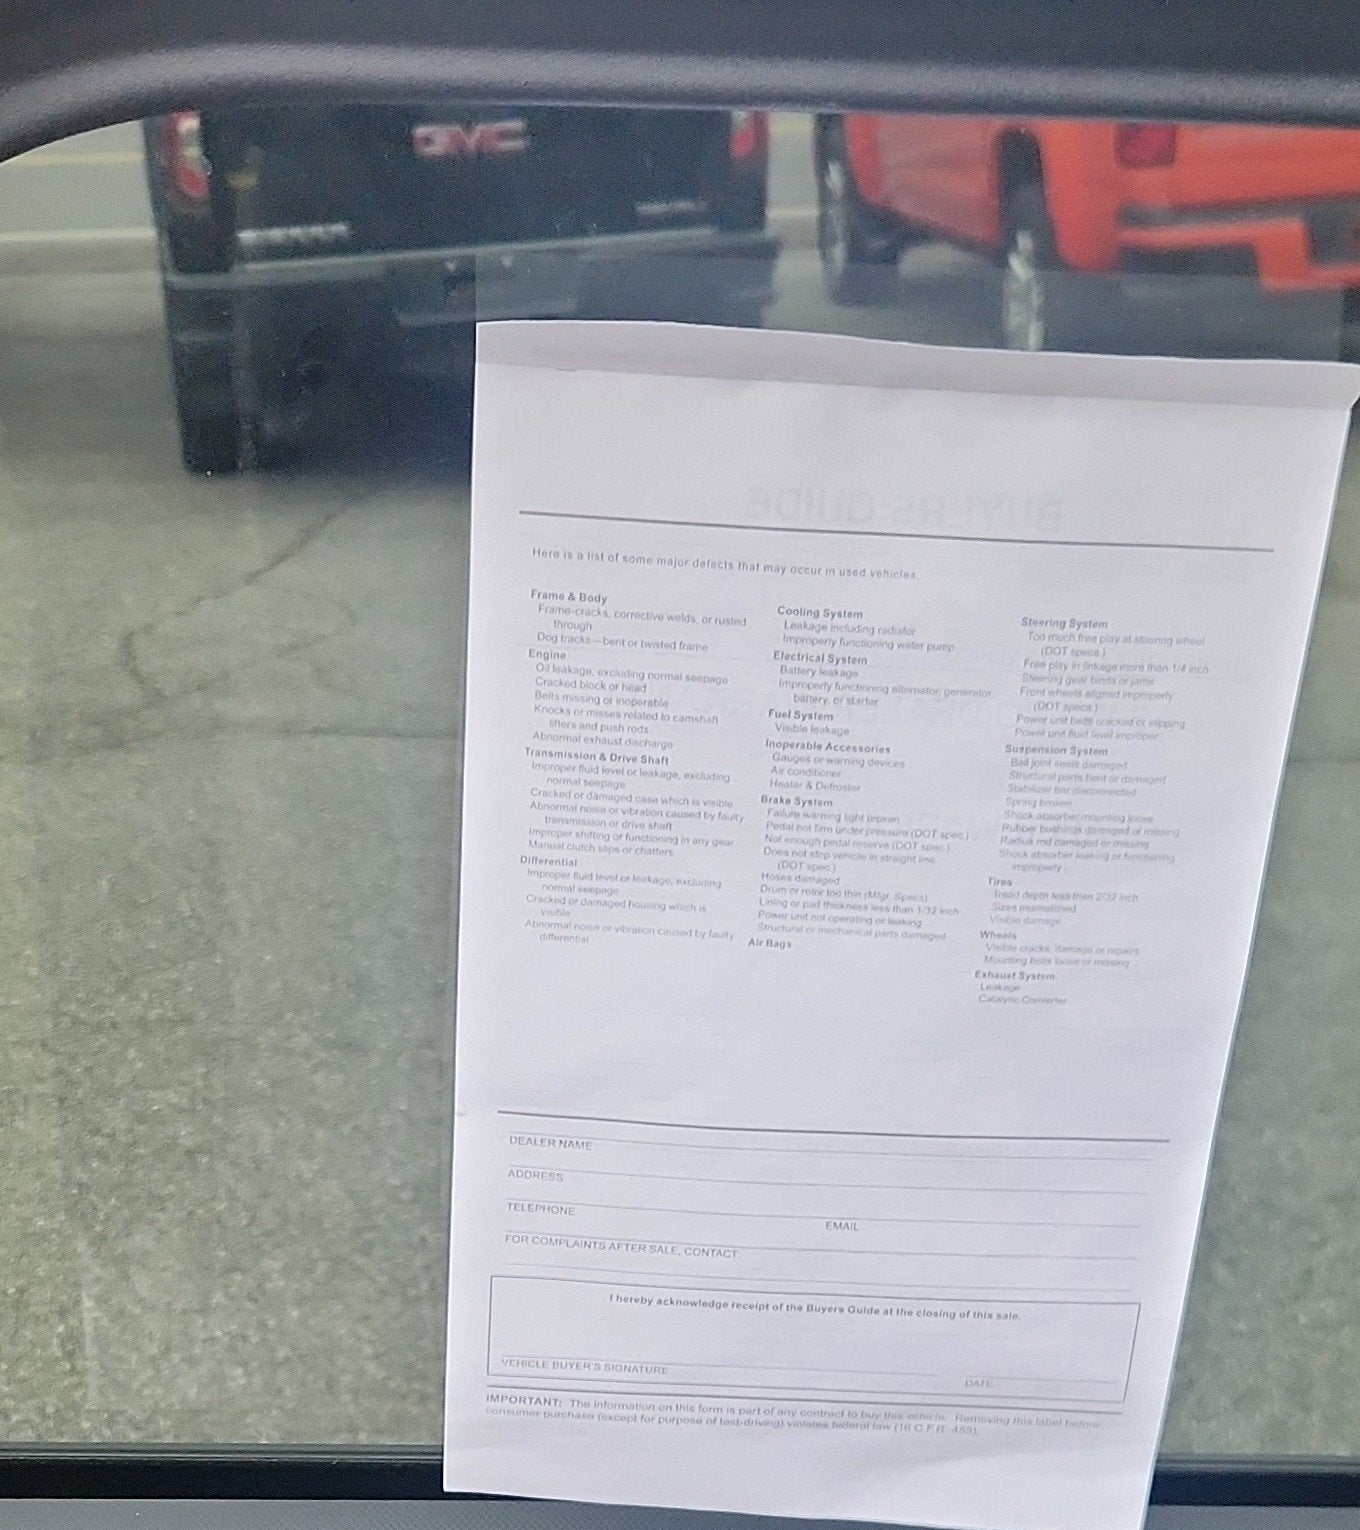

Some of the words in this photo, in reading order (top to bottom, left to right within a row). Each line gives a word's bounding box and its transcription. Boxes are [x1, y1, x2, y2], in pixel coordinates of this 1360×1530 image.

[412, 116, 529, 158] GMC
[532, 547, 560, 559] Here
[562, 549, 573, 560] is
[586, 550, 604, 562] list
[606, 552, 619, 563] of
[621, 555, 653, 565] some
[655, 555, 689, 569] major
[691, 557, 734, 570] defects
[736, 560, 760, 571] that
[762, 564, 786, 575] may
[789, 565, 821, 574] occur
[824, 564, 835, 575] in
[838, 565, 866, 576] used
[530, 588, 565, 600] Frame
[567, 590, 576, 601] &
[578, 591, 608, 605] Body
[777, 604, 820, 619] Cooling
[822, 606, 863, 621] System
[553, 618, 593, 633] through
[1021, 616, 1066, 630] Steering
[1068, 617, 1108, 631] System
[528, 647, 566, 662] Engine
[773, 649, 825, 662] Electrical
[827, 652, 867, 667] System
[535, 675, 577, 688] Cracked
[579, 678, 606, 690] block
[608, 682, 618, 691] or
[621, 681, 647, 693] head
[768, 707, 791, 718] Fuel
[793, 708, 834, 723] System
[765, 737, 822, 753] Inoperable
[824, 740, 891, 754] Accessories
[1005, 742, 1067, 756] Suspension
[1069, 744, 1108, 757] System
[525, 745, 596, 760] Transmission
[598, 750, 607, 761] &
[609, 751, 638, 763] Drive
[640, 753, 669, 765] Shaft
[761, 792, 791, 804] Brake
[793, 794, 833, 809] System
[520, 853, 578, 866] Differential
[988, 875, 1013, 886] Tires
[980, 928, 1017, 939] Wheels
[748, 935, 763, 946] Air
[765, 936, 792, 950] Bags
[974, 968, 1016, 979] Exhaust
[1018, 969, 1055, 982] System
[509, 1135, 556, 1147] DEALER
[558, 1138, 592, 1149] NAME
[507, 1168, 564, 1182] ADDRESS
[506, 1201, 575, 1215] TELEPHONE
[825, 1220, 859, 1231] EMAIL
[504, 1234, 529, 1245] FOR
[531, 1235, 606, 1250] COMPLAINTS
[608, 1240, 646, 1252] AFTER
[615, 1292, 653, 1307] hereby
[656, 1294, 728, 1311] acknowledge
[730, 1298, 769, 1313] receipt
[771, 1301, 783, 1311] of
[785, 1301, 803, 1312] the
[805, 1302, 844, 1316] Buyers
[846, 1304, 880, 1315] Guide
[882, 1305, 893, 1315] at
[895, 1306, 913, 1316] the
[915, 1306, 956, 1320] closing
[958, 1308, 970, 1318] of
[972, 1309, 993, 1319] this
[995, 1309, 1021, 1320] sale.
[501, 1356, 549, 1369] VEHICLE
[603, 1362, 668, 1375] SIGNATURE
